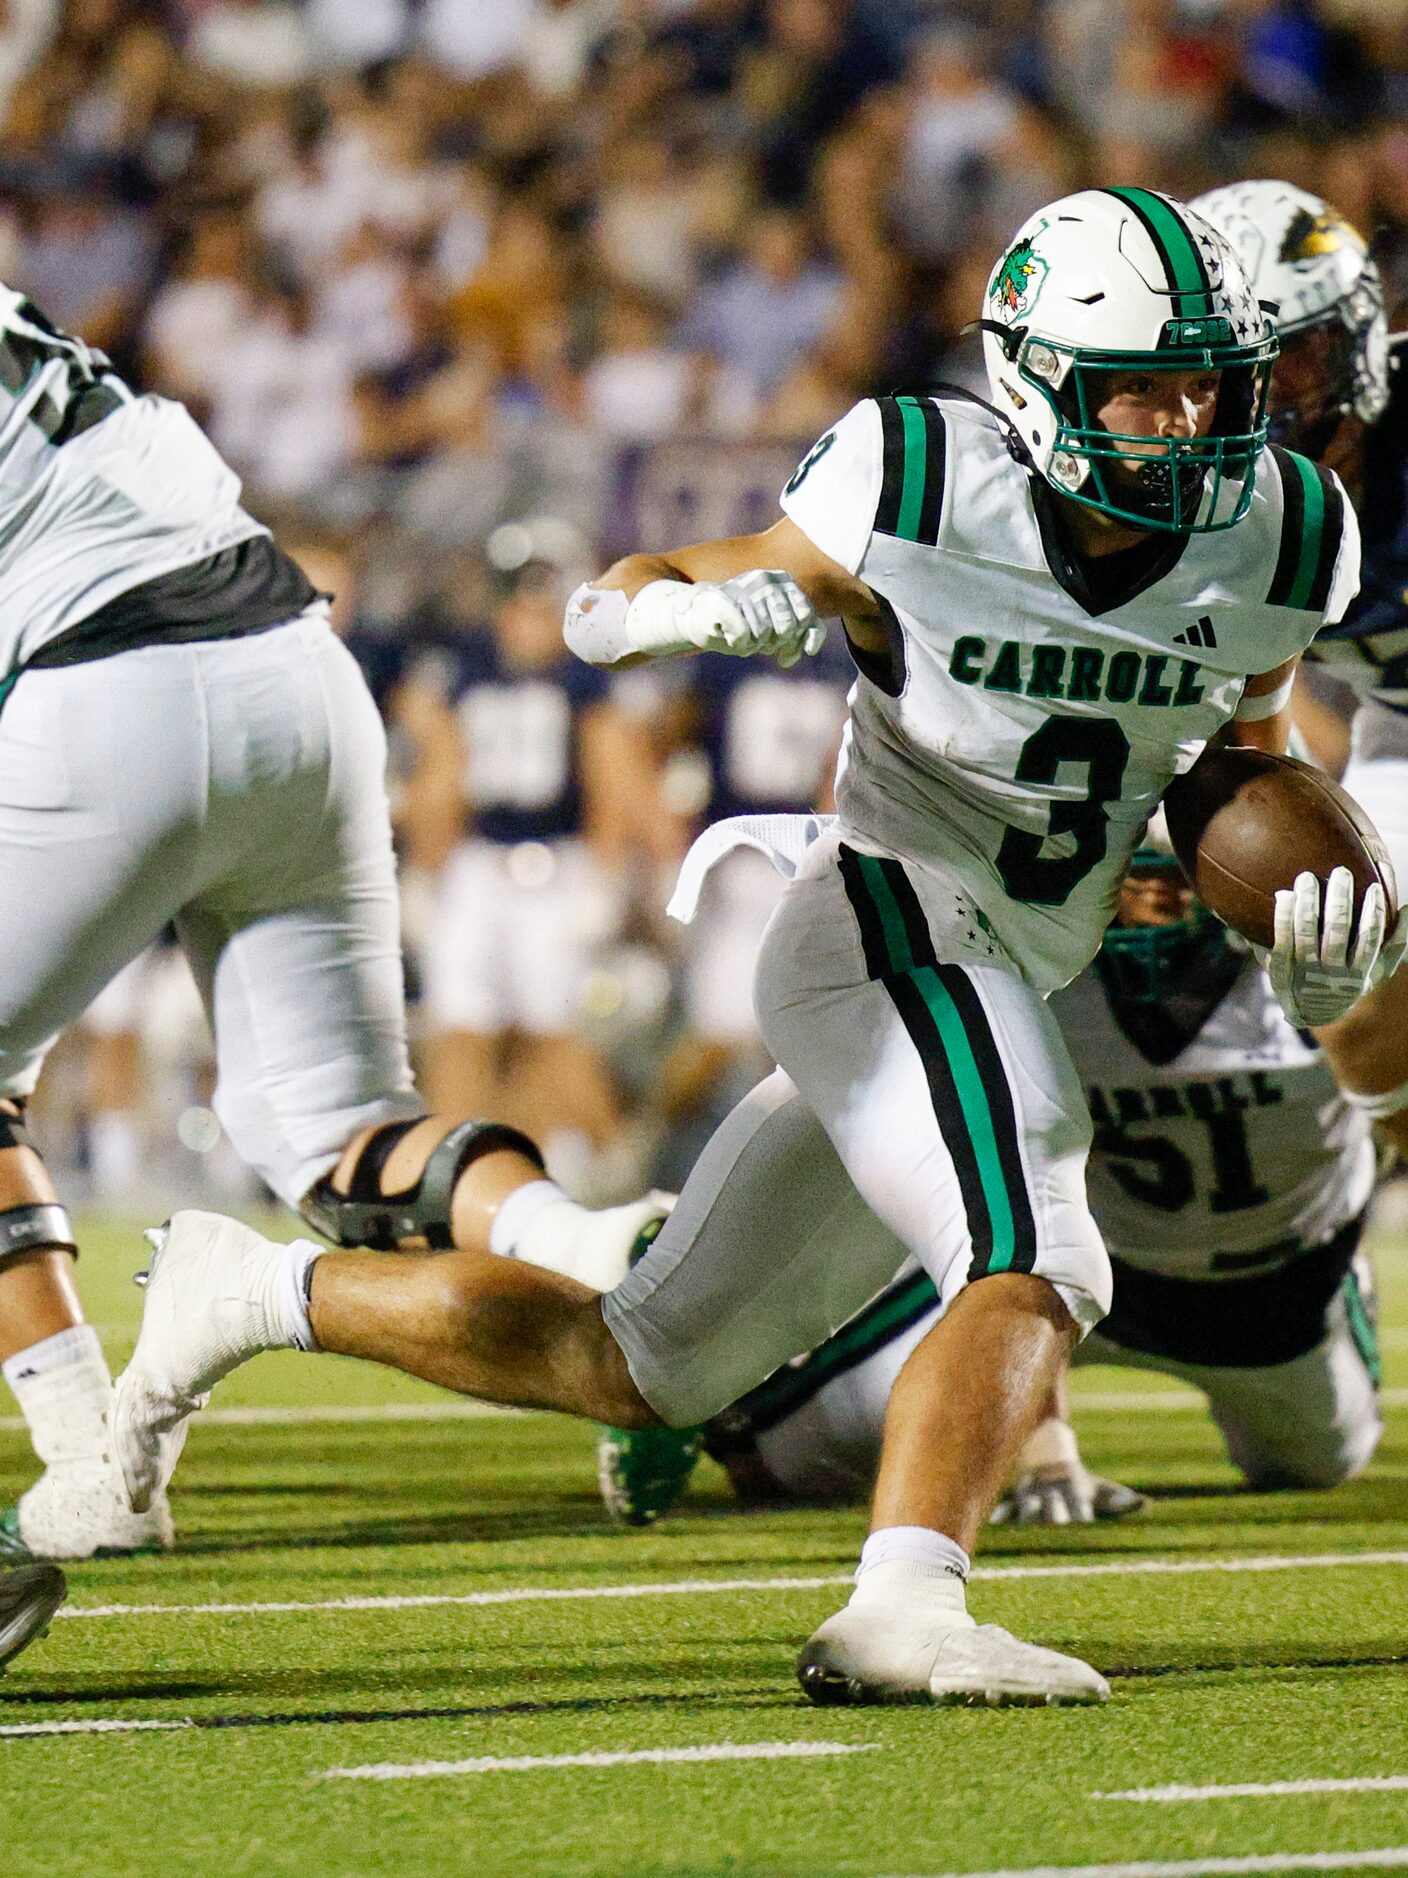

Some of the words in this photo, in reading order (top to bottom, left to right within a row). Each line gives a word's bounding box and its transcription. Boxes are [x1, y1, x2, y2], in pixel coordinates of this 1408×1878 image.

[785, 431, 838, 498] 3
[948, 634, 1206, 708] CARROLL
[994, 714, 1132, 907] 3
[1090, 1103, 1270, 1213] 51
